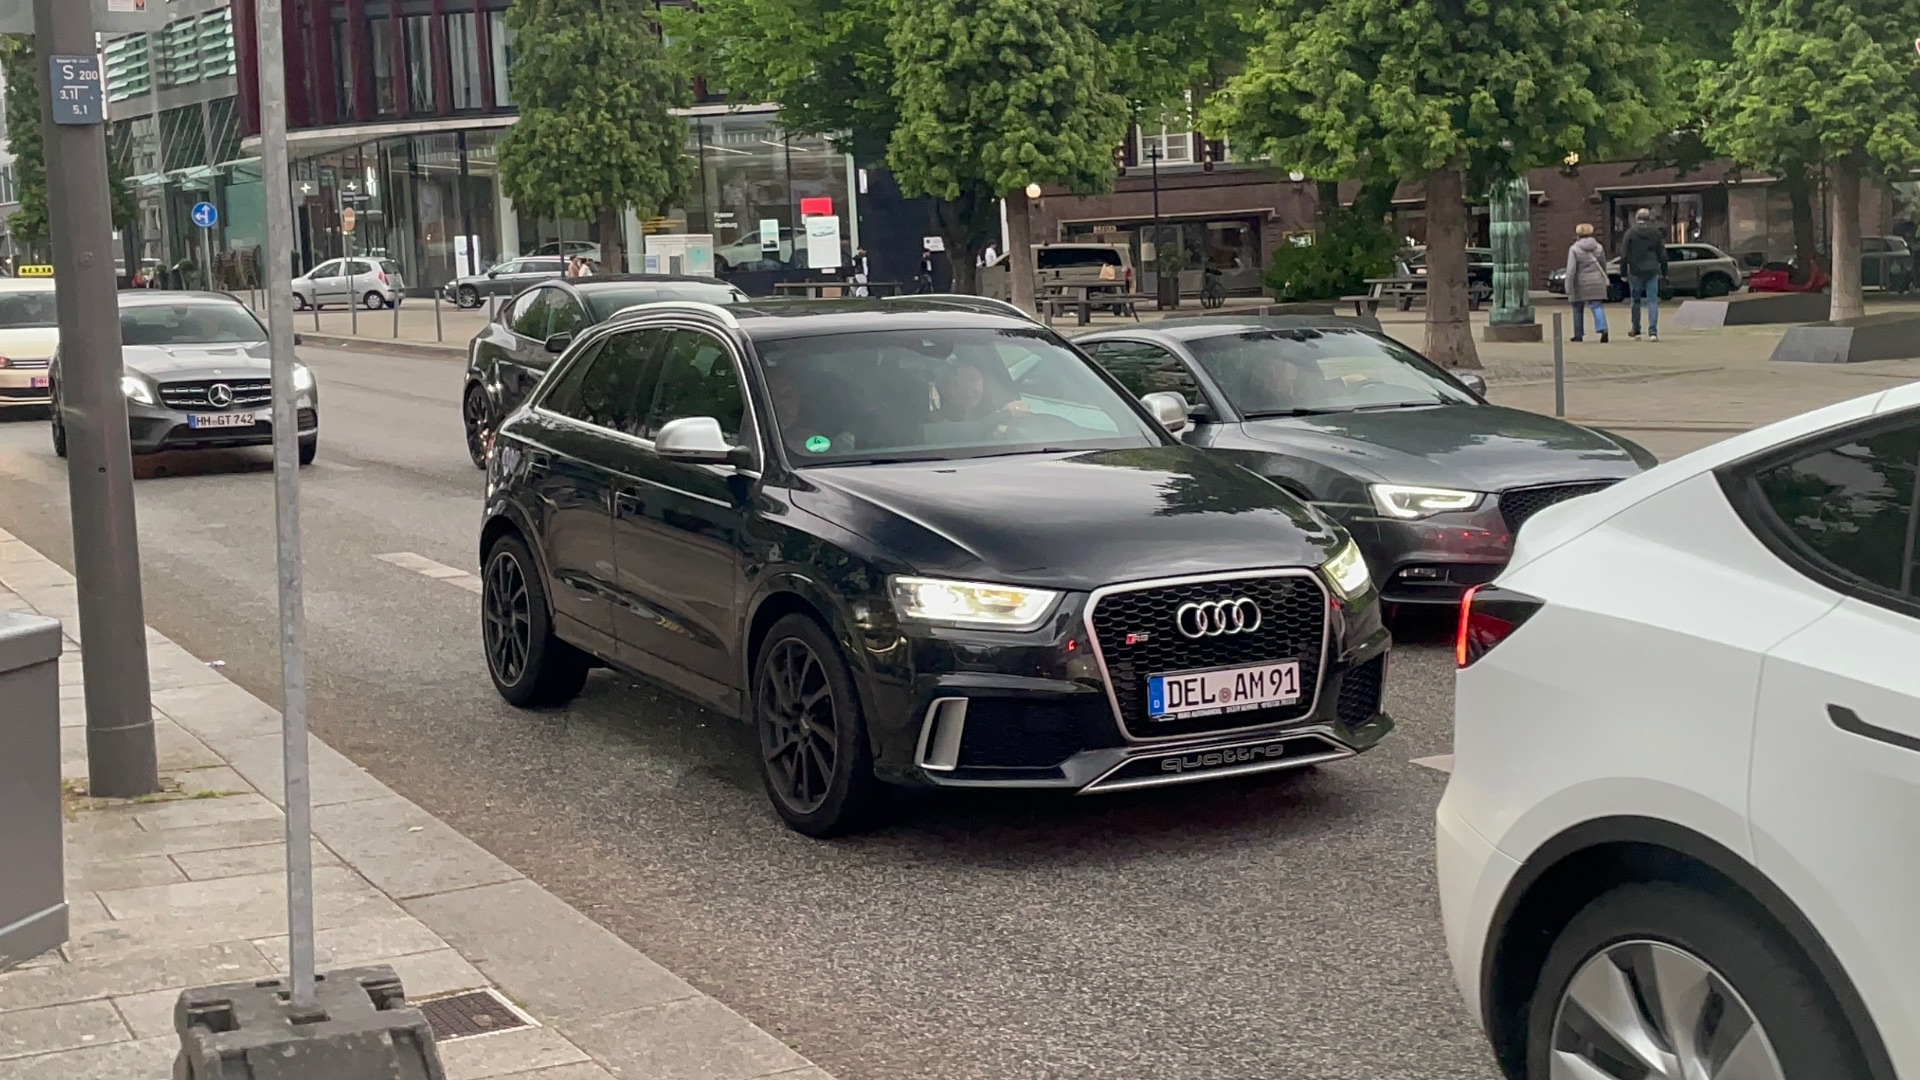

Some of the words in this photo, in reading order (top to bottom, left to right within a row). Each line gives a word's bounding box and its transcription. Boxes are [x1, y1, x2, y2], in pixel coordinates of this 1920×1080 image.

[62, 64, 75, 80] S
[79, 70, 98, 80] 200
[196, 416, 210, 426] HH
[217, 415, 232, 425] GT
[234, 414, 254, 424] 742
[1154, 699, 1160, 708] D
[1167, 677, 1216, 708] DEL
[1234, 671, 1264, 701] AM
[1269, 667, 1297, 696] 91
[1161, 744, 1284, 772] quattro
